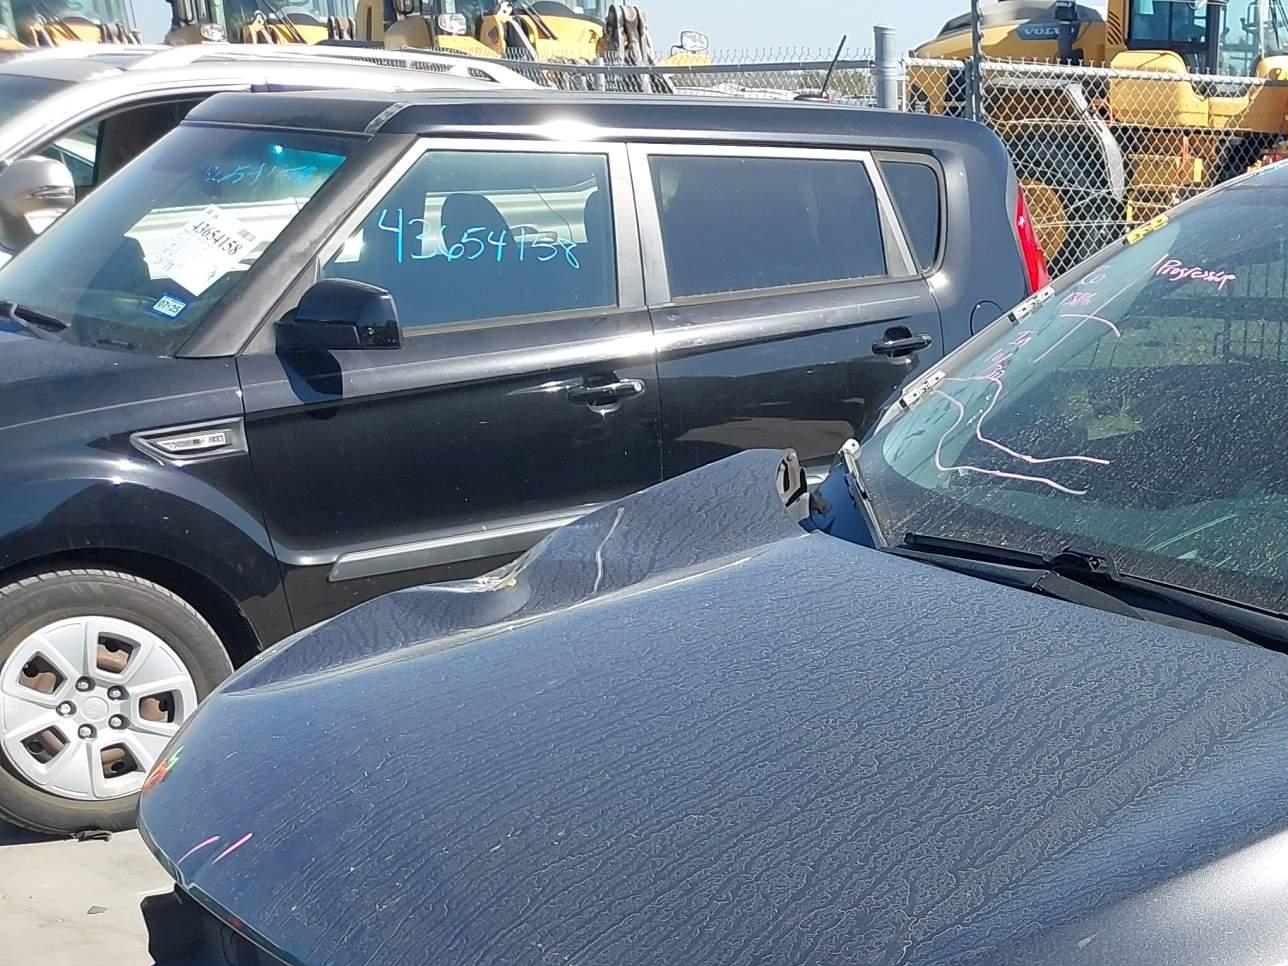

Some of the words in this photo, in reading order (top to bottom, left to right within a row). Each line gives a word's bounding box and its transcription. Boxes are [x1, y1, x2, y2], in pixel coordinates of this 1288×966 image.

[1023, 27, 1075, 36] VOLV
[192, 220, 244, 256] 43654158
[377, 207, 580, 269] 43654158
